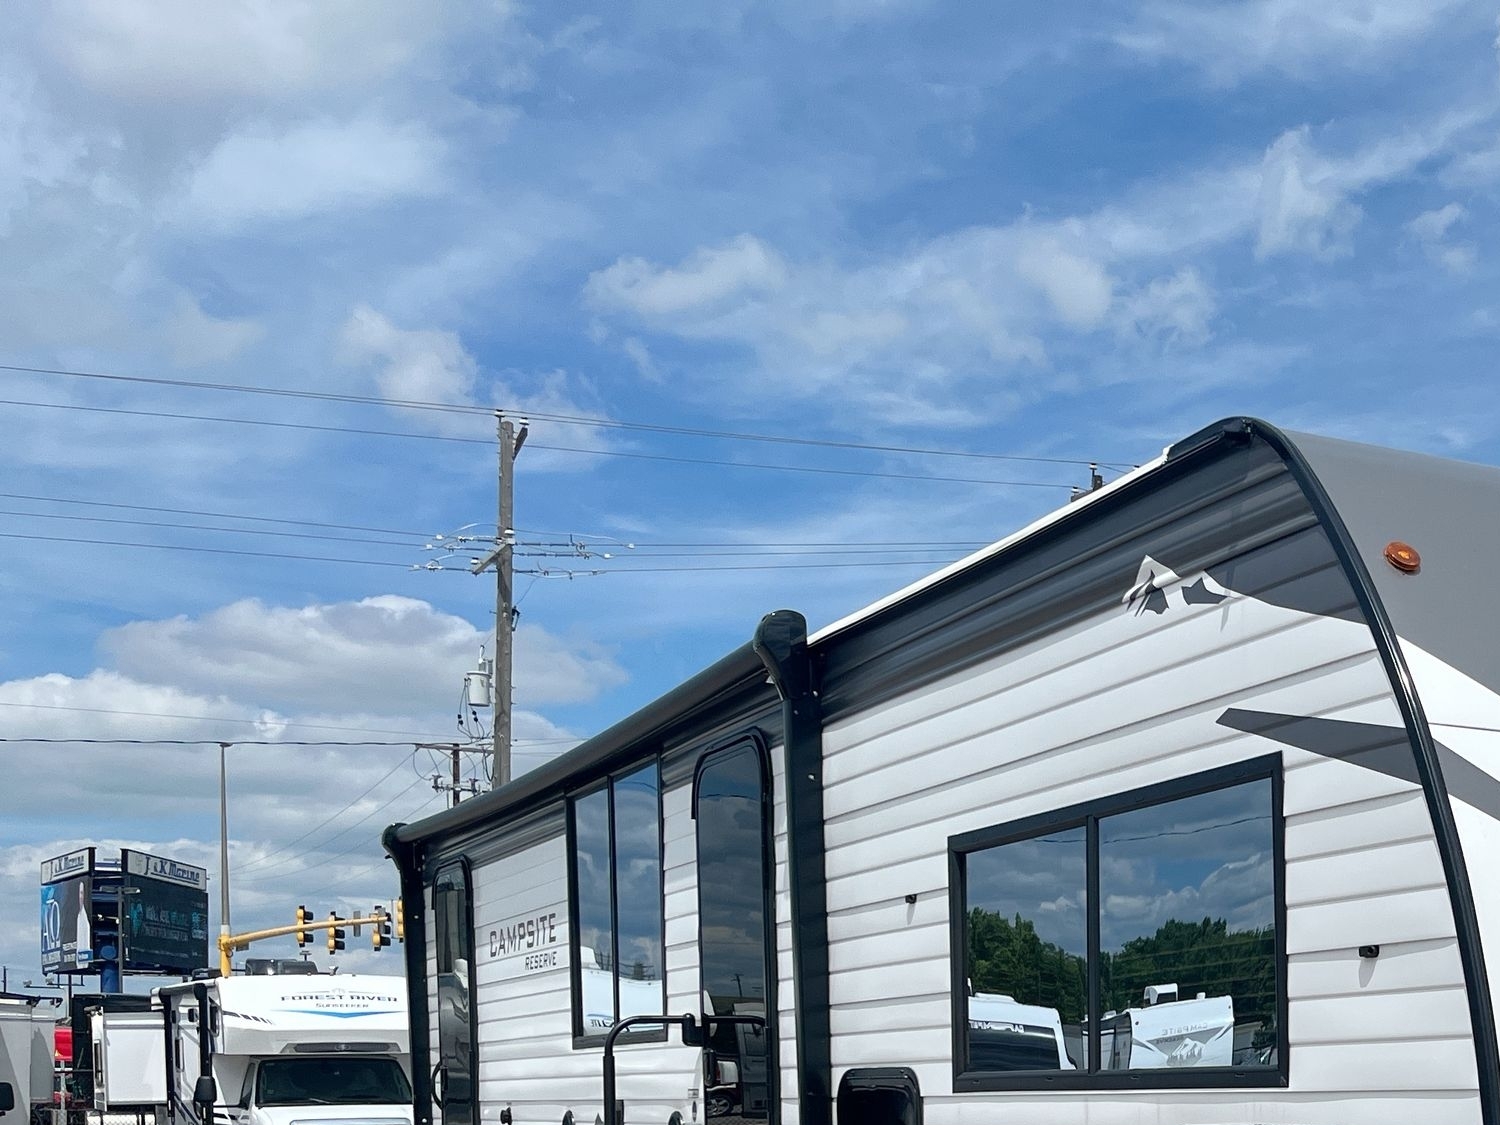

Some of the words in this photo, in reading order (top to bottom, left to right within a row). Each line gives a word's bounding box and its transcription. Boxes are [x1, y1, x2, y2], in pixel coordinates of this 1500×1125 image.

[169, 862, 200, 882] Marine
[489, 912, 557, 958] CAMPSITE
[524, 951, 557, 971] RESERVE
[281, 994, 344, 1002] FOREST
[350, 994, 398, 1002] RIVER
